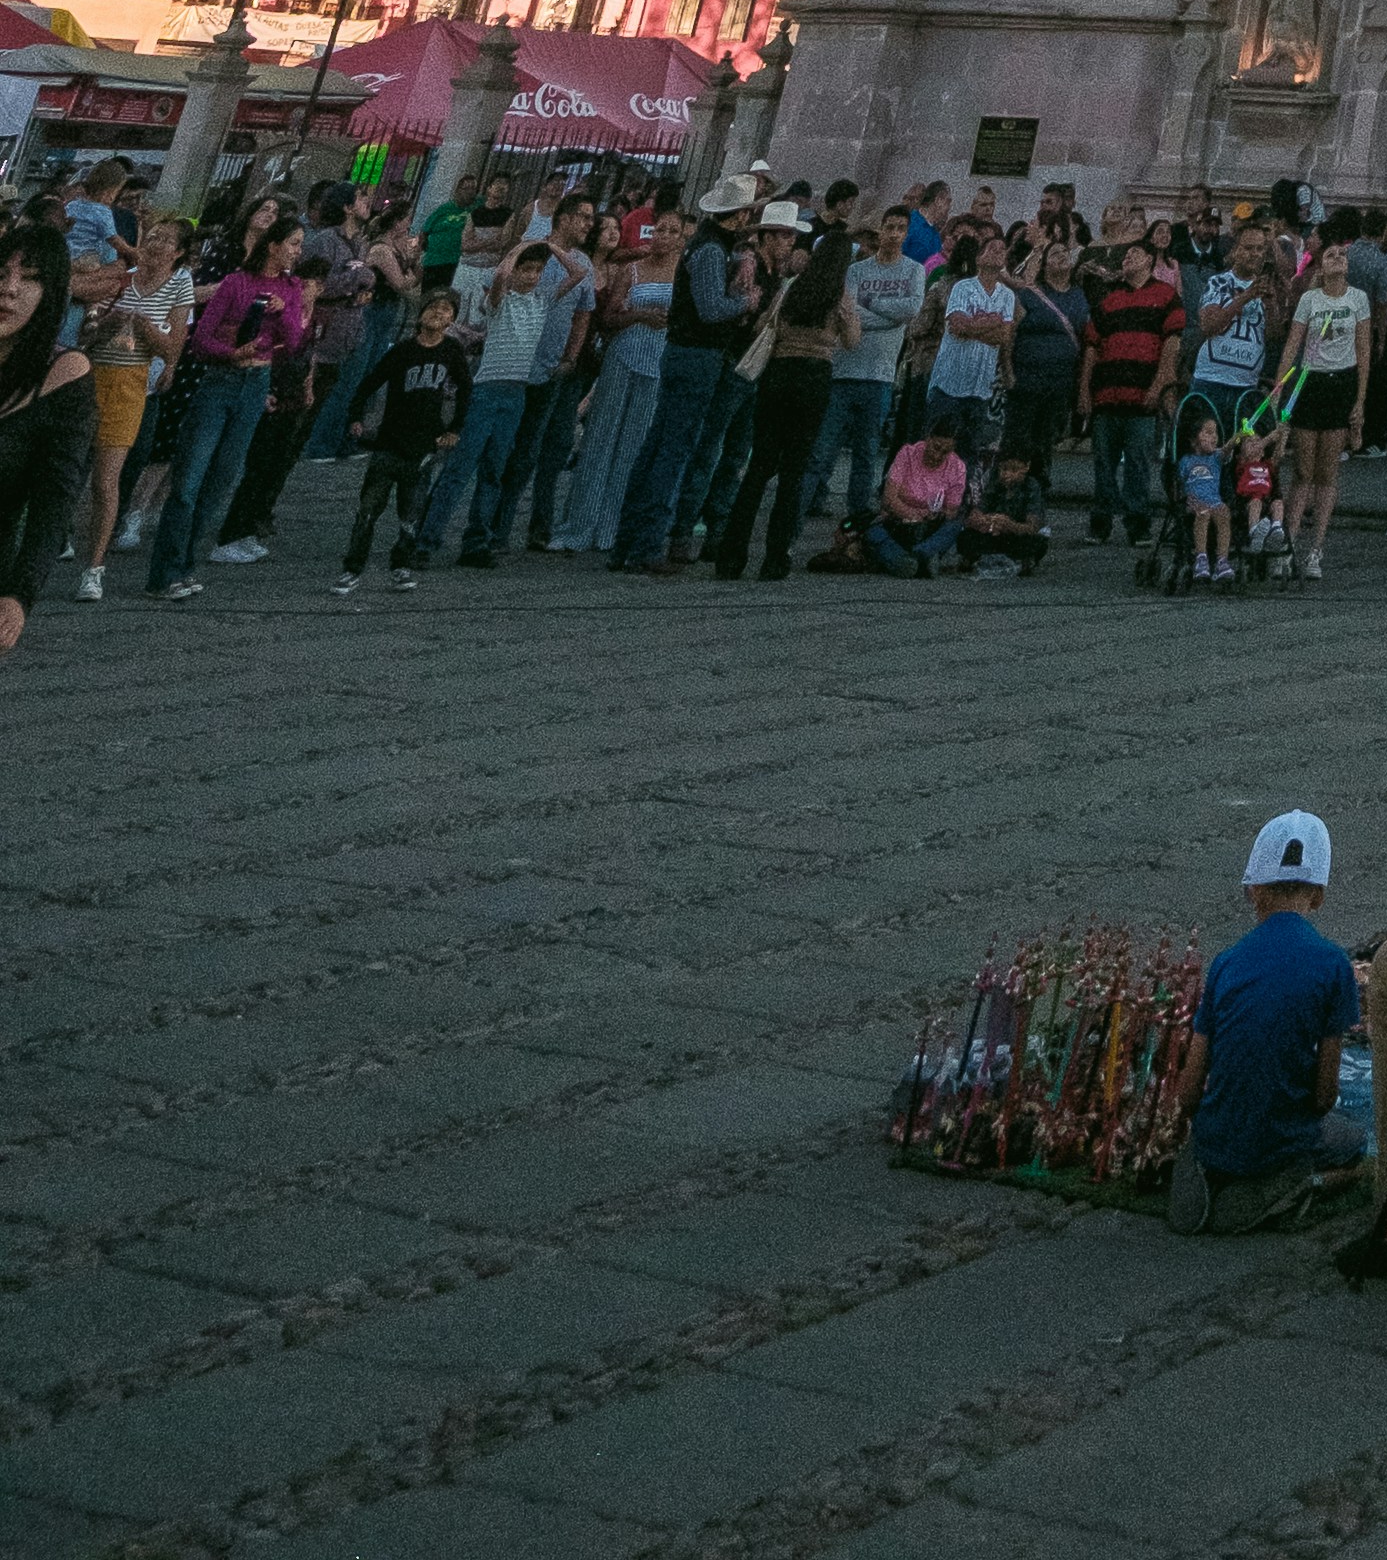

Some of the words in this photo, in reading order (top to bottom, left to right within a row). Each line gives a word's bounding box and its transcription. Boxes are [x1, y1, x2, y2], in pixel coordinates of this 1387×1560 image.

[505, 82, 598, 119] a-Cola
[629, 92, 698, 126] Coca-C
[1219, 345, 1253, 361] BLACK
